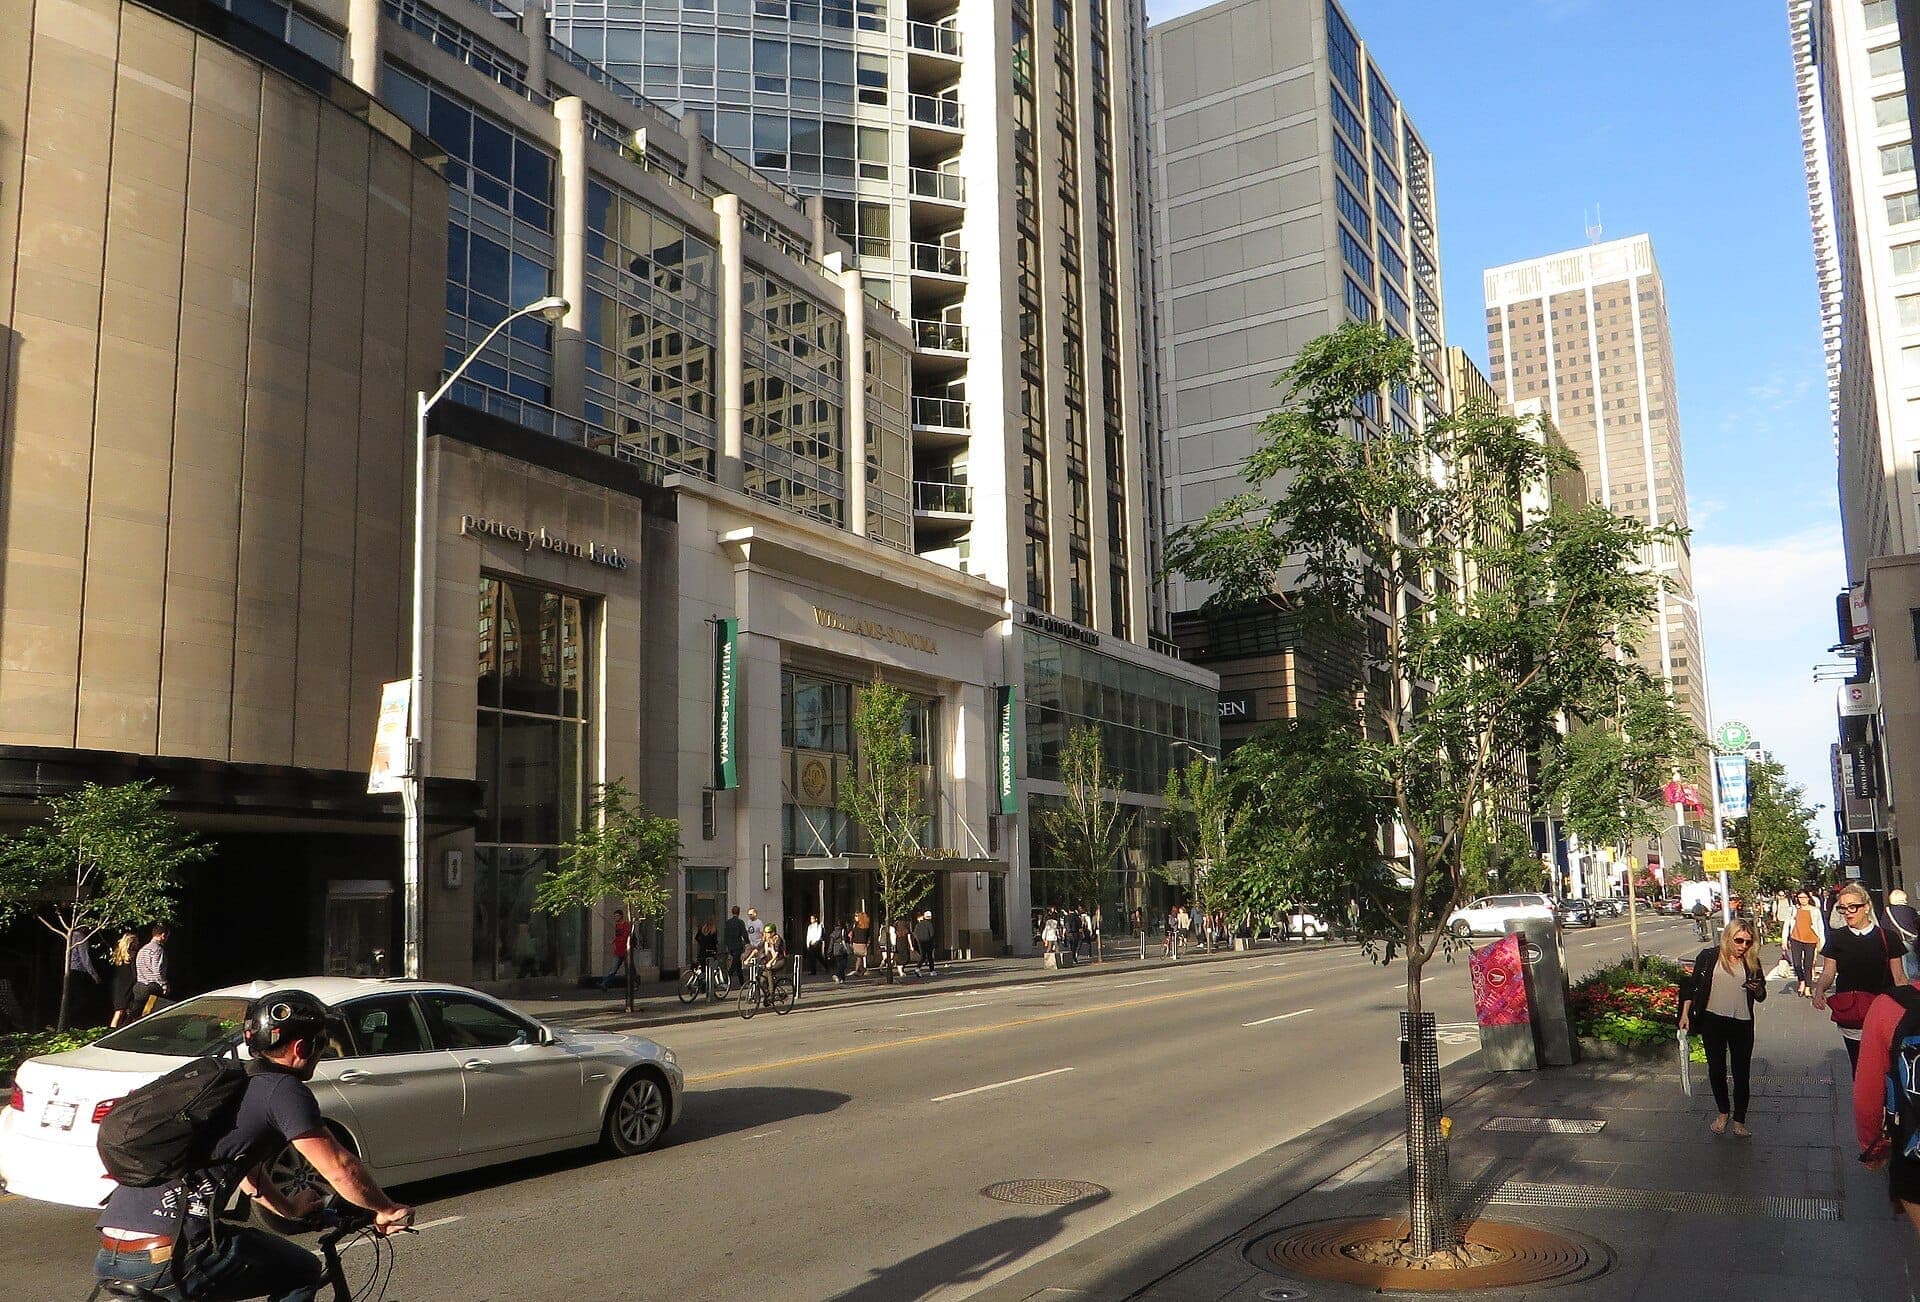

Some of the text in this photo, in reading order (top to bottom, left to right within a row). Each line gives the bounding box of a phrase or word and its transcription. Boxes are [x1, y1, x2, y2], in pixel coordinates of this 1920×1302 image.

[459, 514, 629, 570] pottery barn kids
[812, 605, 939, 656] WILLIAMS-SONOMA
[719, 641, 732, 765] WILLIAMS-SONOMA
[1218, 700, 1246, 717] SEN
[1002, 703, 1012, 797] WILLIAMS-SONOMA
